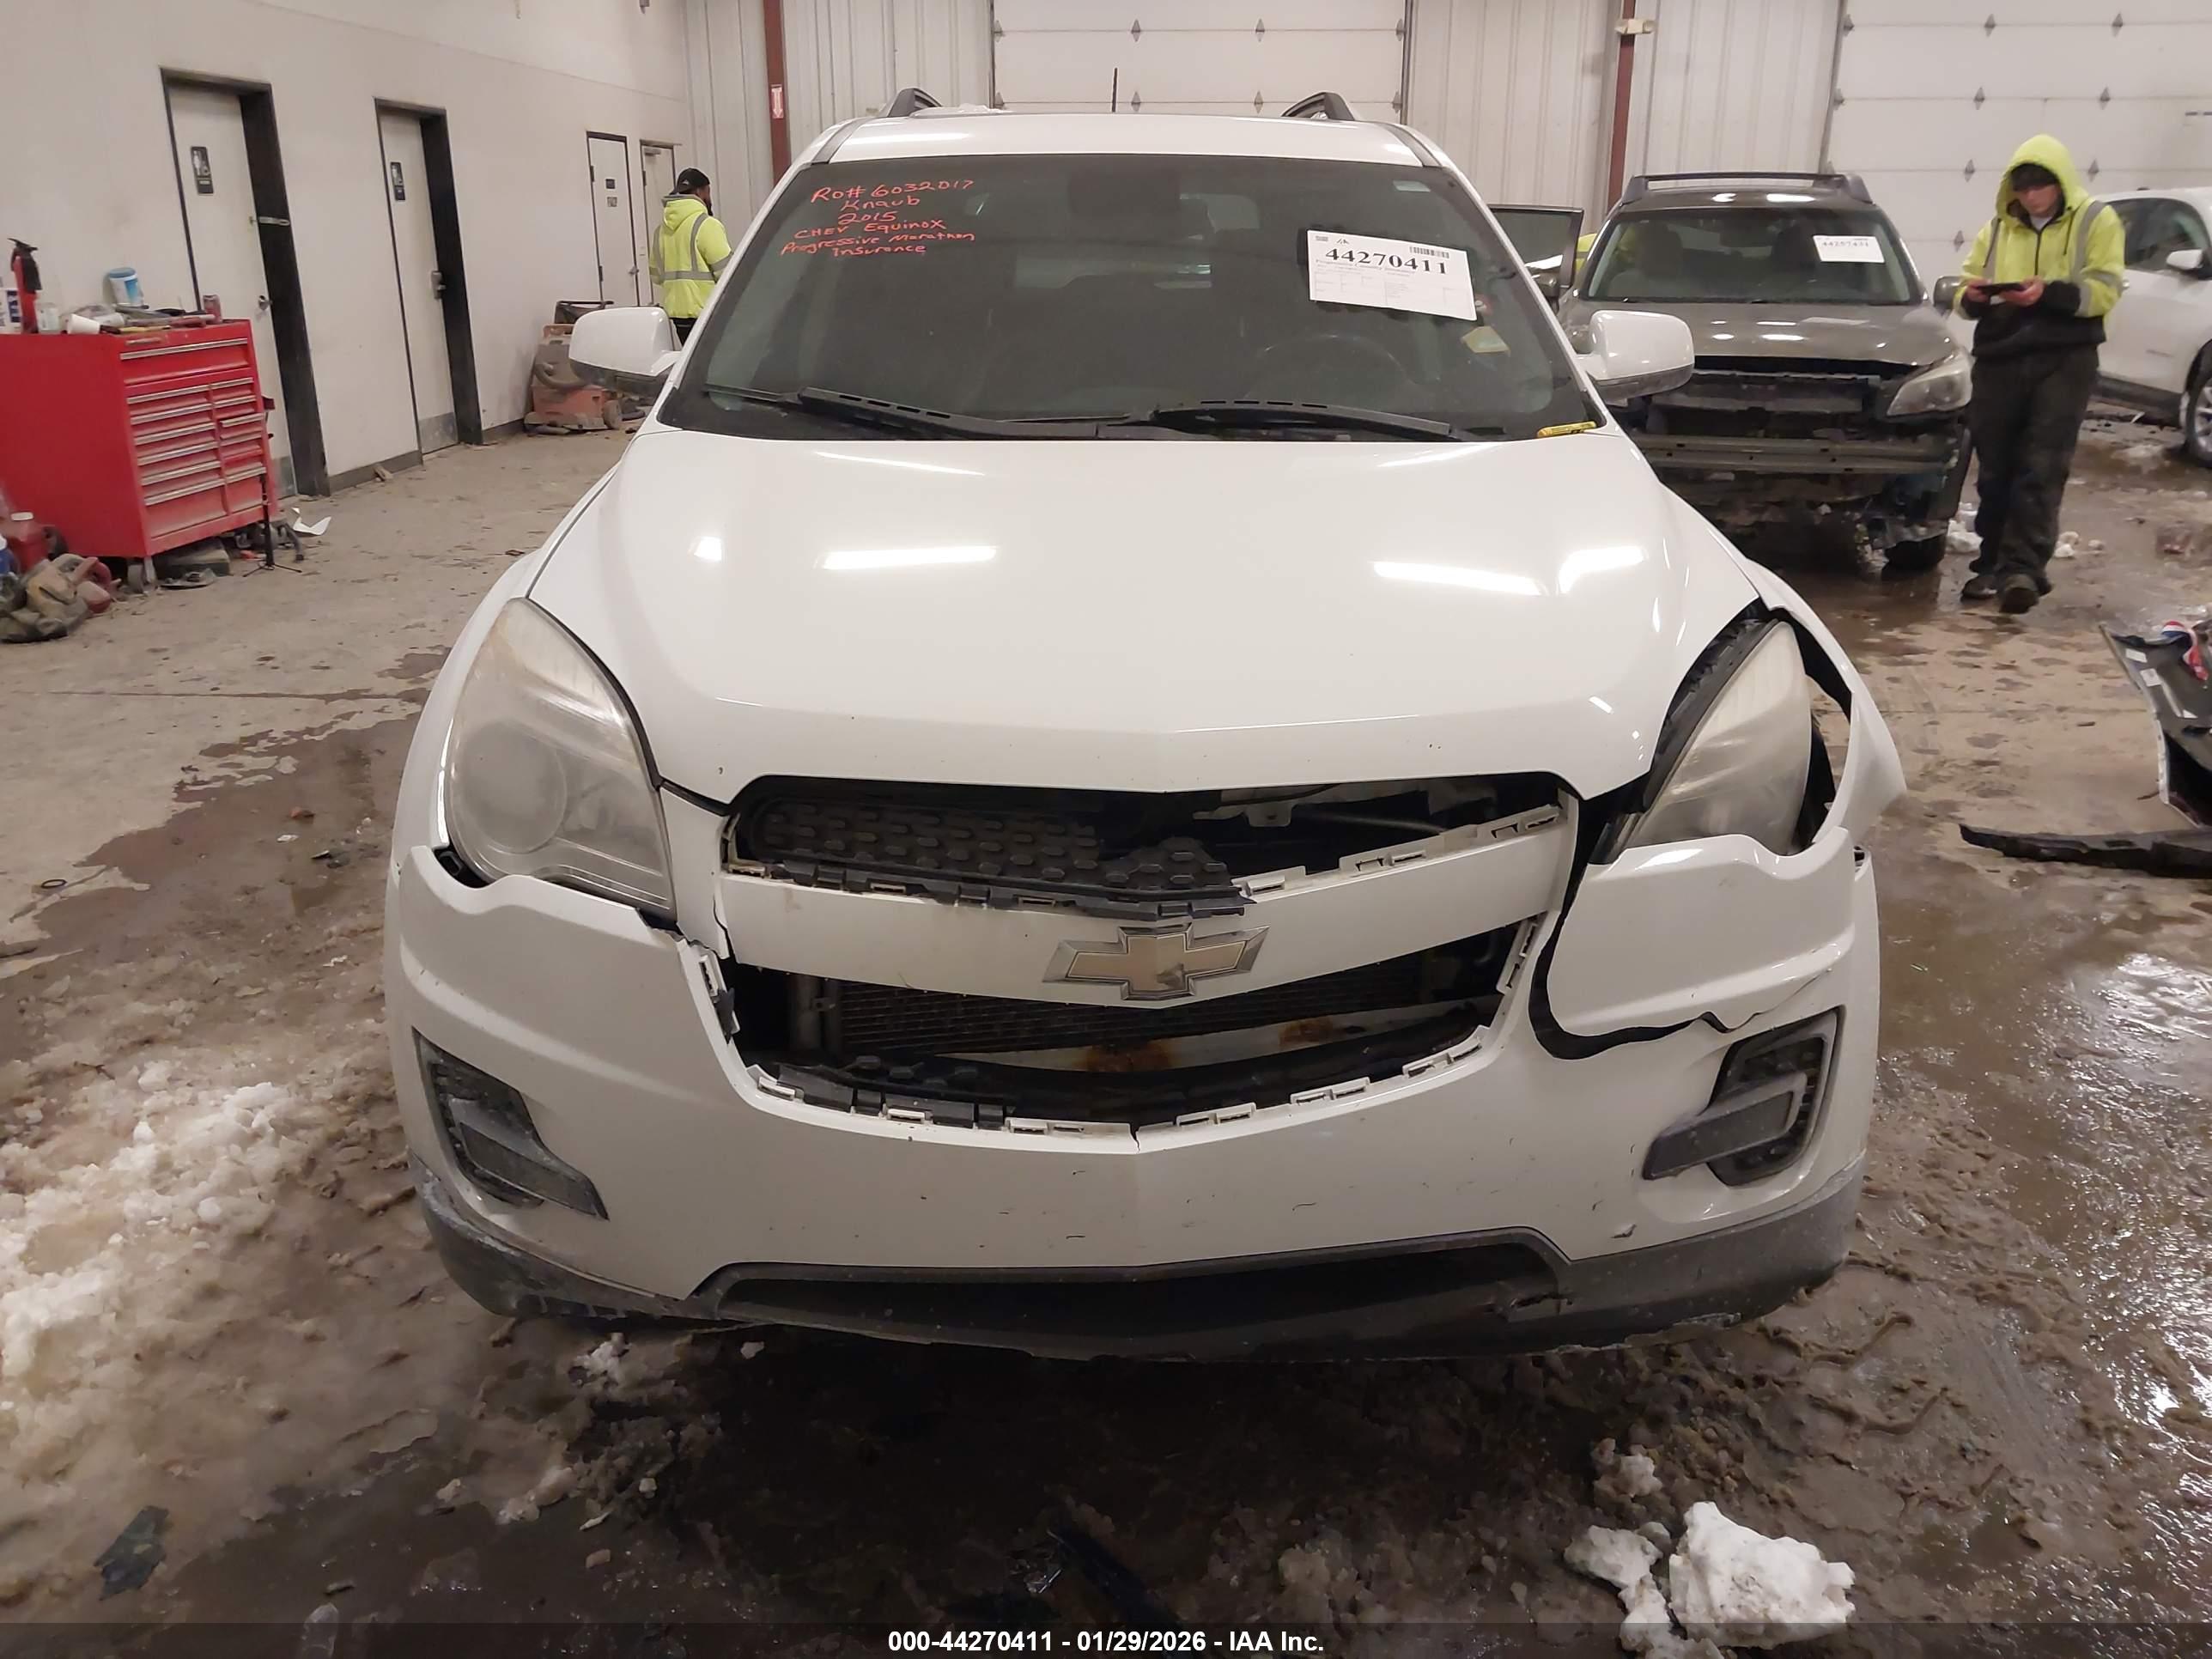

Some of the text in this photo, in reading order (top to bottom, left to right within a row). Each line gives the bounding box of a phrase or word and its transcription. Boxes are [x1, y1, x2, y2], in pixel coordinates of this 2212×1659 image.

[871, 179, 974, 198] 6032017
[838, 210, 899, 225] 2015
[781, 235, 879, 255] Progressive
[1325, 248, 1447, 274] 44270411
